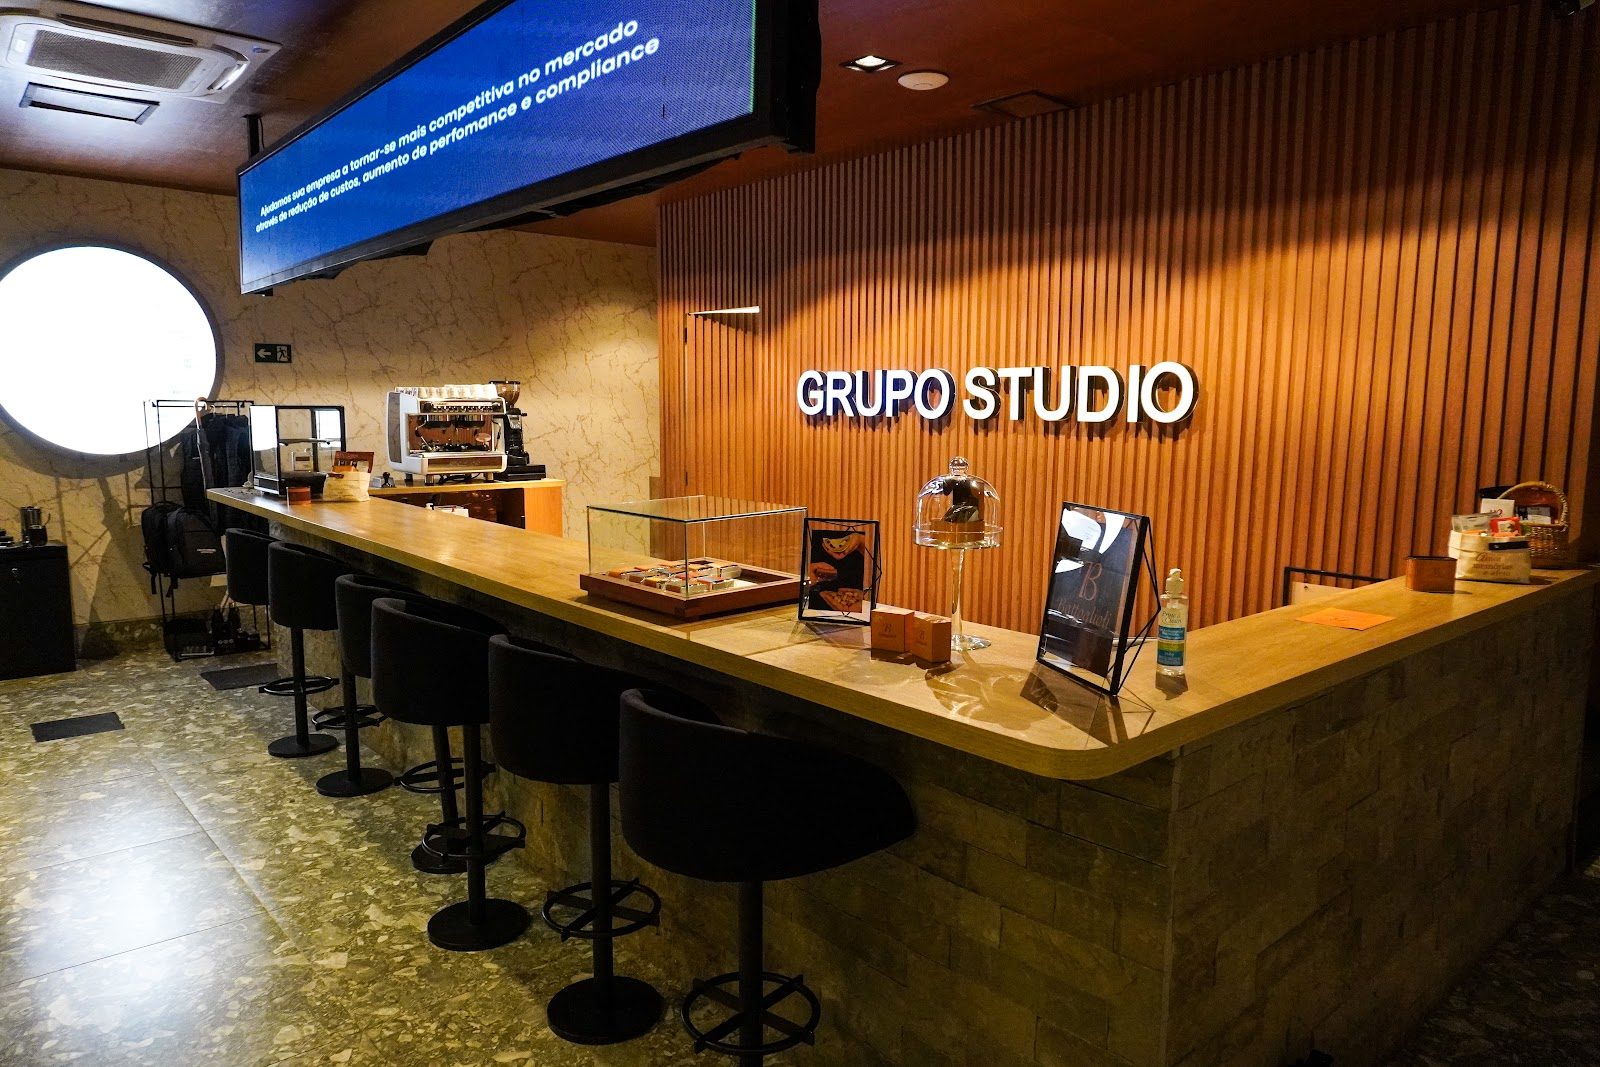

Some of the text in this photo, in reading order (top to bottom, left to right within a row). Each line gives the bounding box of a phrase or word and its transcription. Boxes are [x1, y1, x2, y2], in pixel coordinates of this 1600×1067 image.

[260, 19, 638, 217] Ajudamos sua empresa a tornar-se mais competitiva no mercado
[279, 210, 287, 221] de
[318, 189, 329, 204] de
[330, 173, 361, 198] custos,
[362, 152, 409, 184] aumento
[412, 144, 427, 161] de
[430, 101, 518, 156] perfomance
[521, 95, 532, 111] e
[535, 37, 660, 104] compliance
[796, 361, 1198, 423] GRUPO STUDIO
